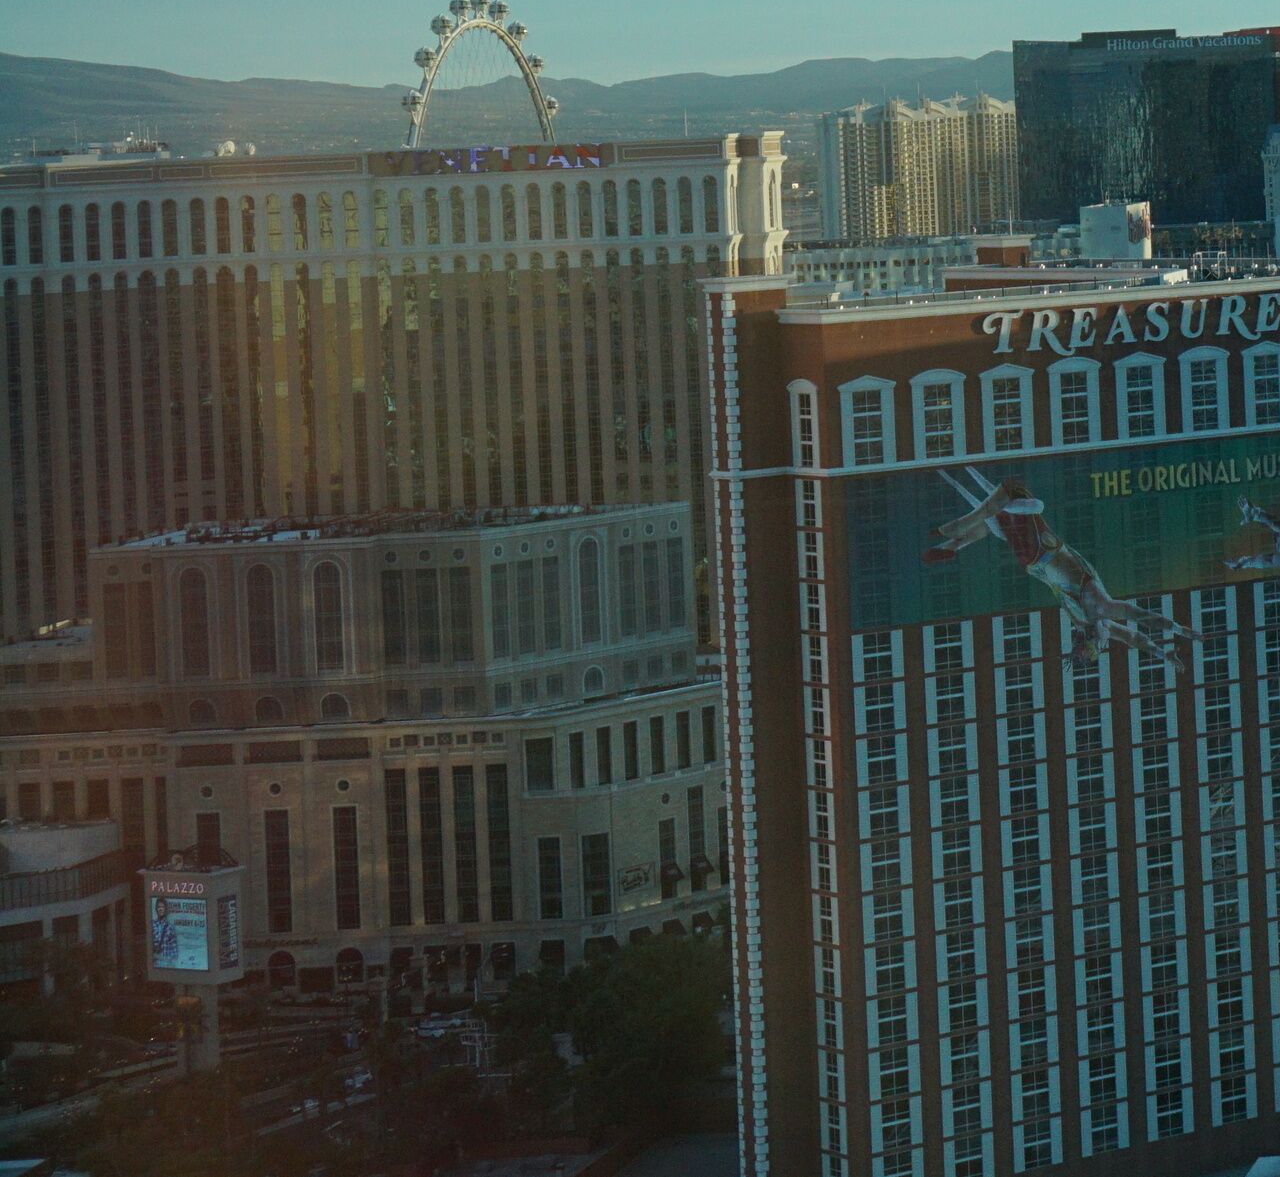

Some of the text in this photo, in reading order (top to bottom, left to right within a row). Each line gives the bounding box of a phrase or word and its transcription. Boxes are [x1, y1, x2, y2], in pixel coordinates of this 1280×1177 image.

[1107, 34, 1262, 51] Hilton Grand Vacations
[1090, 470, 1132, 499] THE
[1138, 458, 1241, 492] ORIGINAL
[151, 881, 205, 894] PALAZZO
